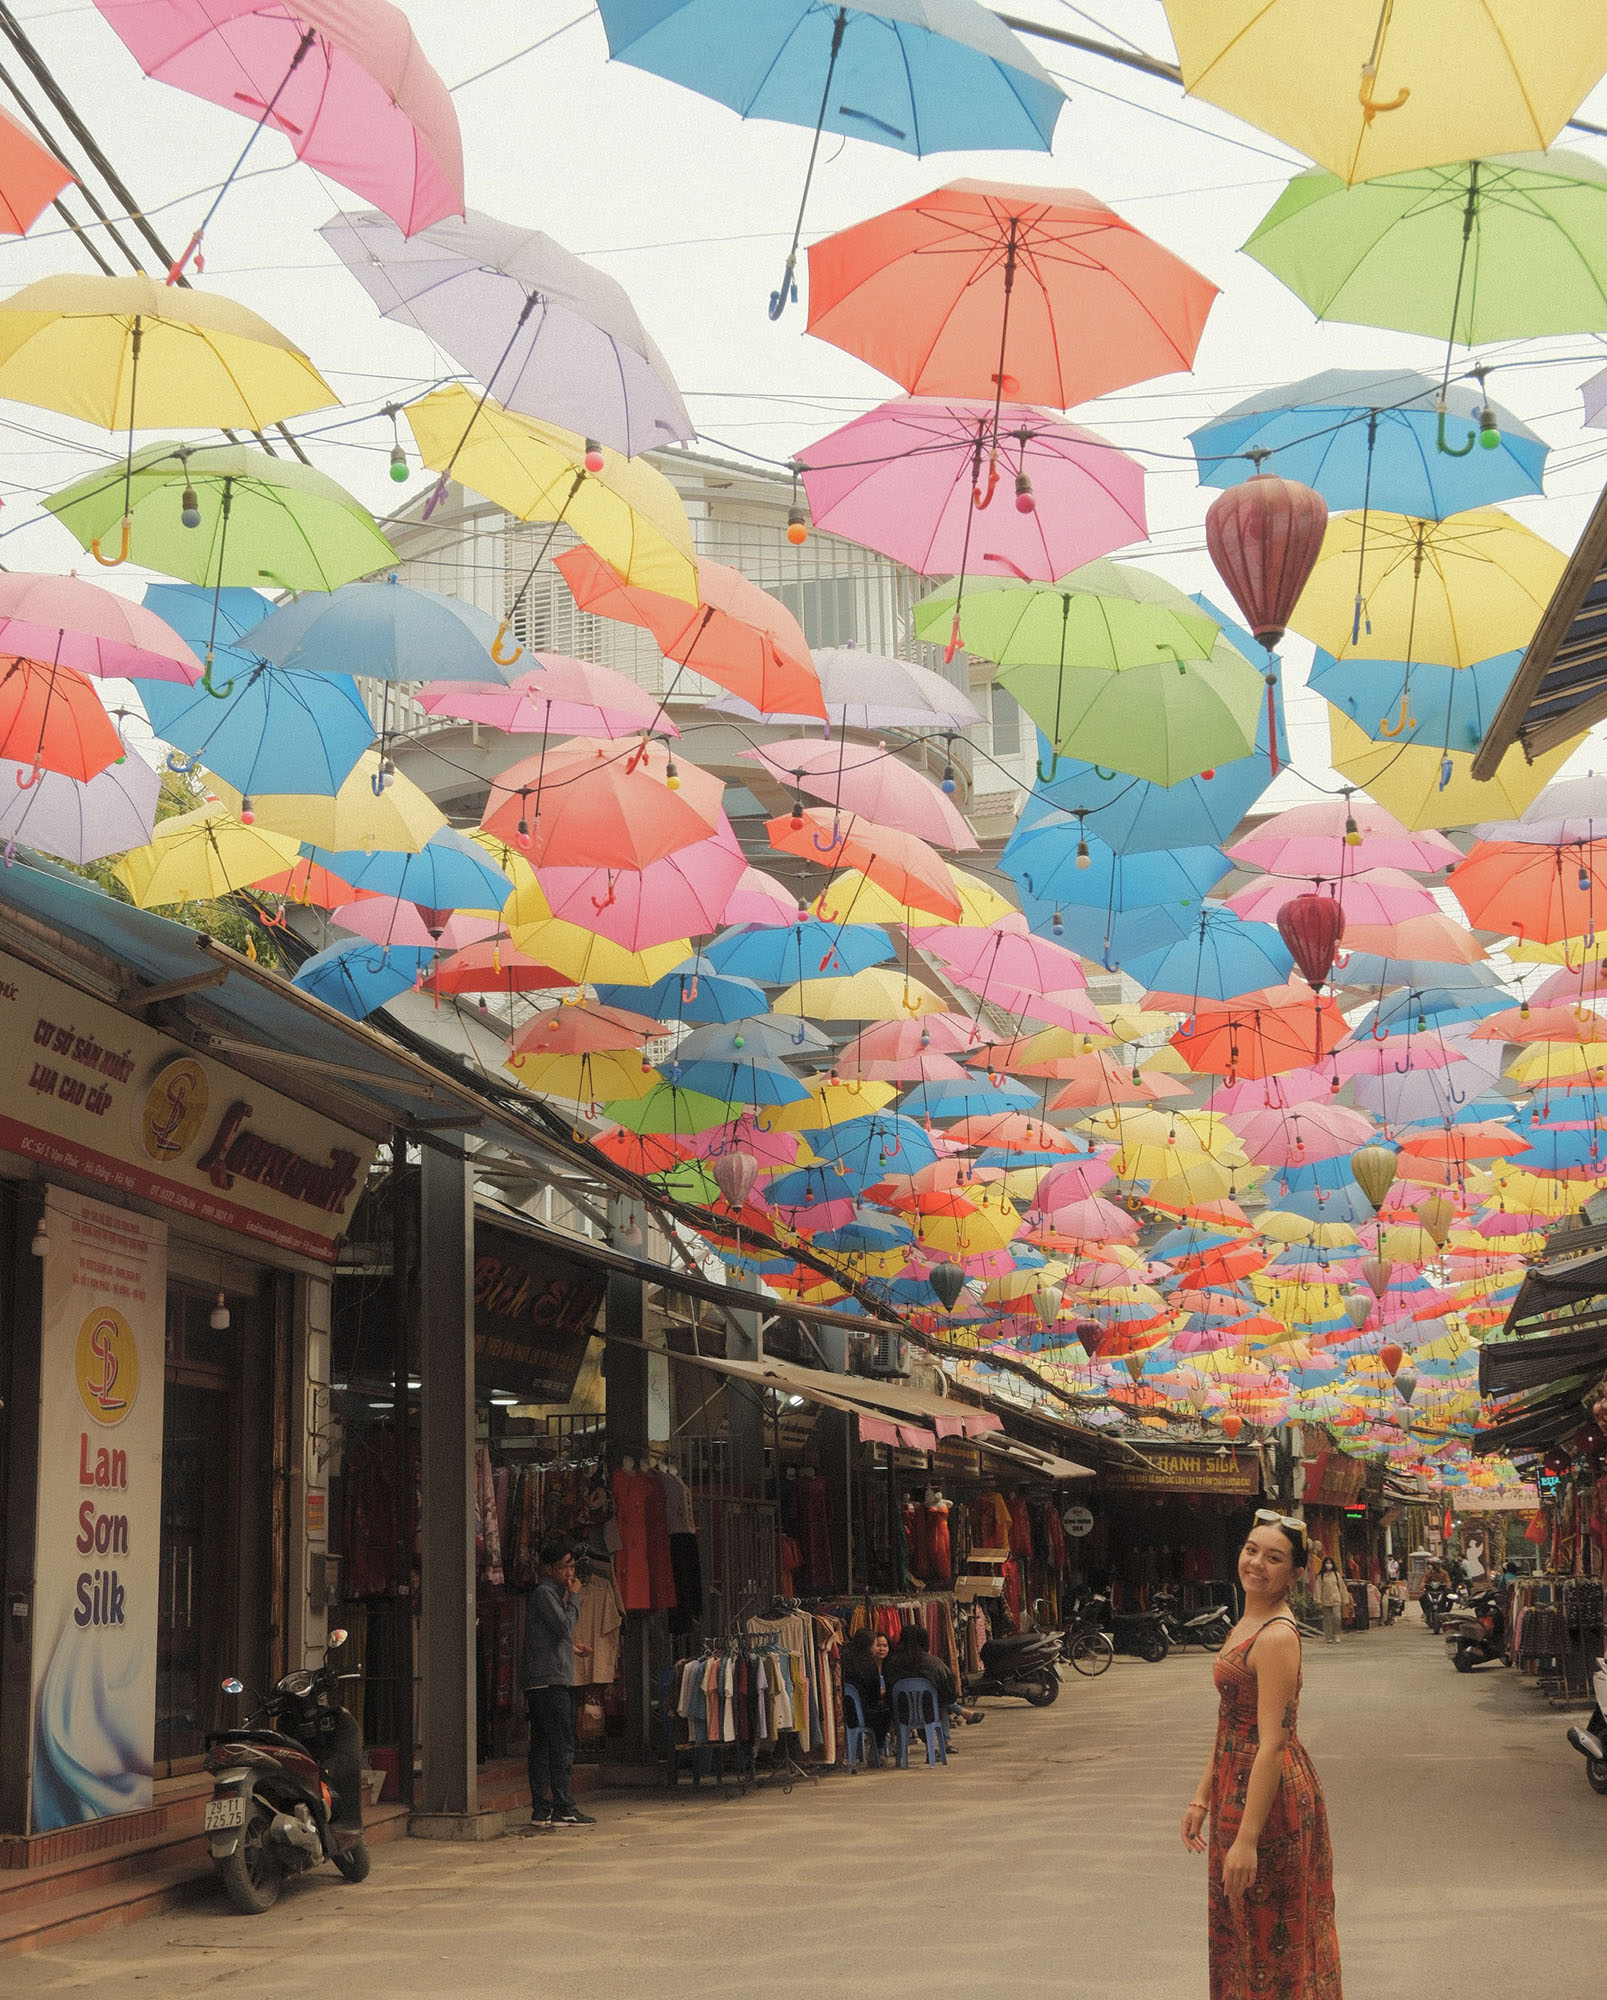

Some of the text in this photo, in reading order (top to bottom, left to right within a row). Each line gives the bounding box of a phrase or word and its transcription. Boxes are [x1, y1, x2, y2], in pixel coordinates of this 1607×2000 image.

[58, 1075, 87, 1106] CAO
[85, 1082, 113, 1116] CẤP
[79, 1432, 127, 1488] Lan
[76, 1499, 128, 1554] Sơn
[74, 1568, 125, 1627] Silk
[206, 1811, 242, 1829] 725.75
[210, 1799, 239, 1815] 29-T1
